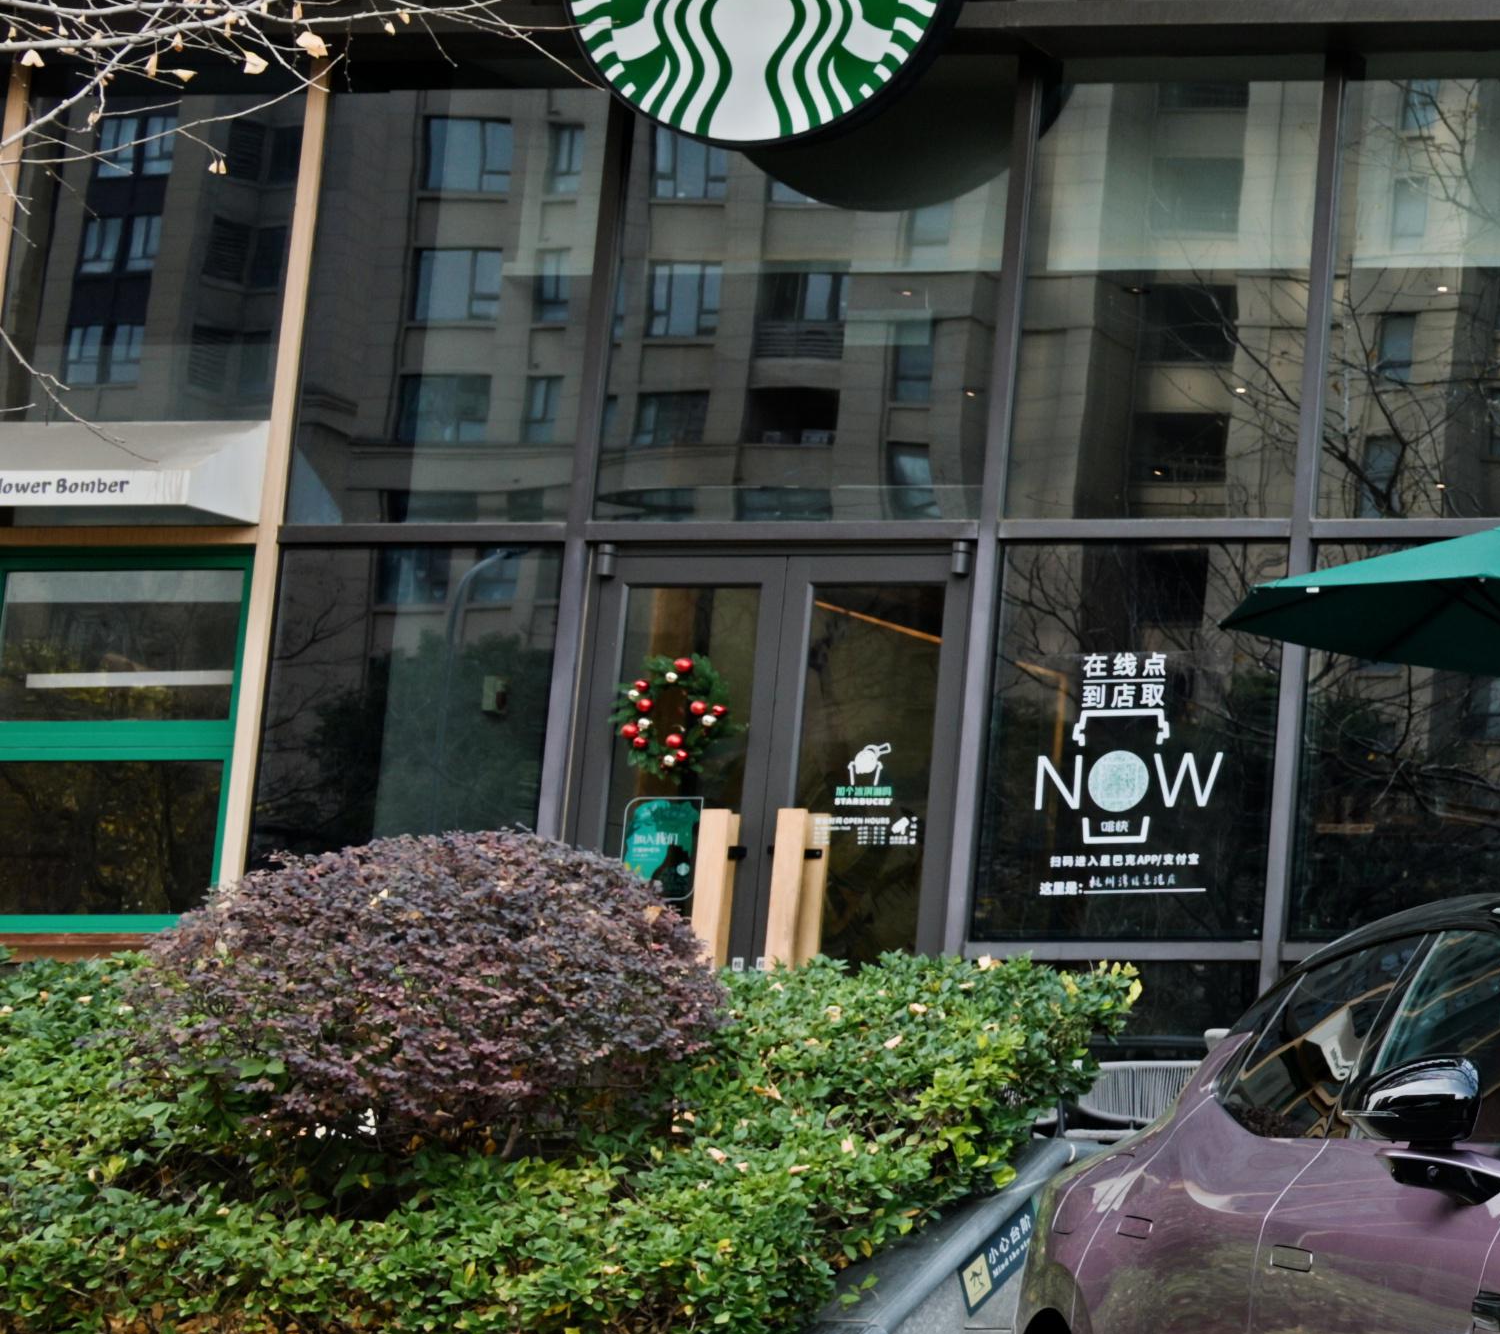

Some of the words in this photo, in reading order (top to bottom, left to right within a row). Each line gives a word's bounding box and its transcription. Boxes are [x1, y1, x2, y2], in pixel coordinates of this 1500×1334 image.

[56, 478, 129, 494] Bomber
[1082, 652, 1167, 678] 在线点
[1081, 683, 1165, 708] 到店取
[1034, 750, 1224, 812] NOW
[843, 816, 863, 825] OPEN
[864, 816, 891, 825] HOURS
[989, 1213, 1032, 1265] 小心台阶
[992, 1257, 1010, 1278] Mind
